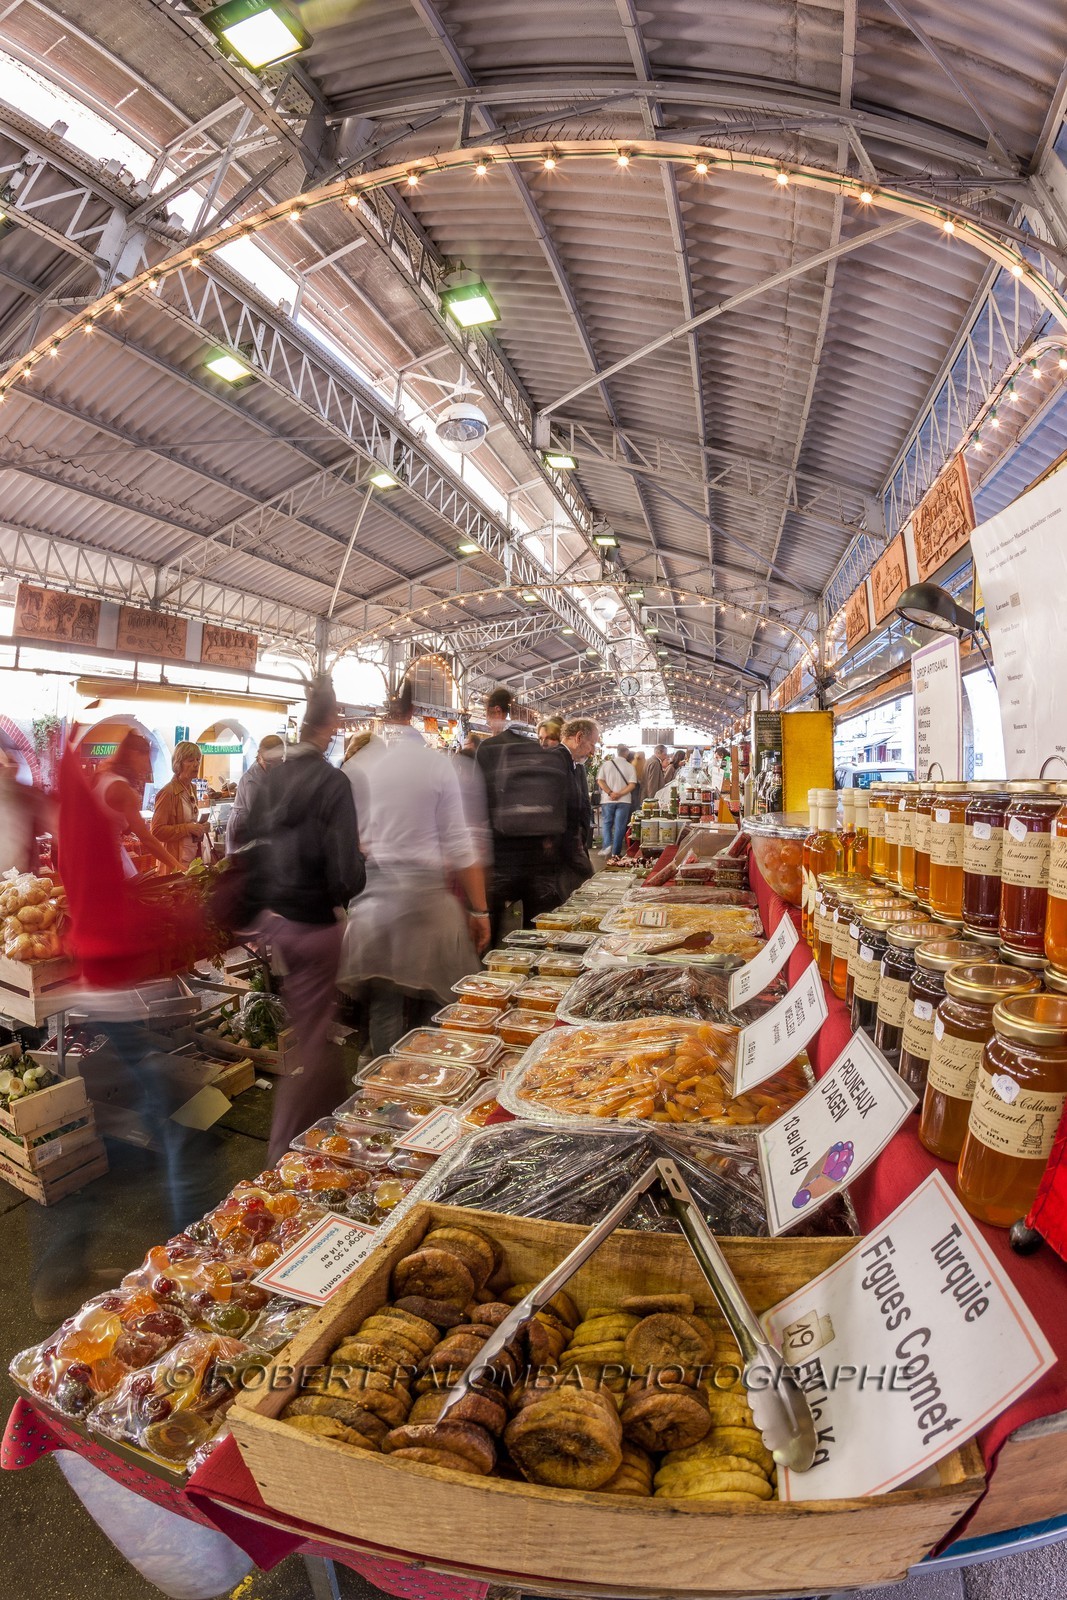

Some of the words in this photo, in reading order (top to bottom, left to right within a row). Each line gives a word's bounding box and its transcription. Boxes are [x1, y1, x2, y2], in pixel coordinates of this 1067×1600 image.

[918, 706, 931, 717] Violette
[918, 719, 931, 729] Mimosa
[918, 732, 927, 741] Rose
[969, 843, 991, 852] Forêt
[1004, 849, 1038, 862] Montagne
[1053, 858, 1067, 869] Till
[794, 997, 805, 1027] ABRICOTS
[785, 1006, 796, 1038] MOELLEUX
[935, 1055, 967, 1072] Tilleul
[838, 1058, 878, 1119] PRUNEAUX
[821, 1078, 850, 1123] D'AGEN
[1020, 1097, 1058, 1113] Collines
[982, 1100, 1027, 1124] Lavande
[784, 1115, 800, 1131] 13
[787, 1129, 801, 1146] eu
[986, 1131, 1009, 1144] DOM
[790, 1139, 807, 1157] le
[308, 1227, 340, 1254] Fabrication
[344, 1228, 358, 1240] 400
[348, 1230, 366, 1247] 250gr
[336, 1240, 344, 1248] gr
[358, 1250, 367, 1259] de
[280, 1255, 308, 1279] artisanale
[342, 1259, 360, 1274] fruits
[930, 1222, 993, 1324] Turquie
[319, 1274, 342, 1294] confits
[787, 1323, 814, 1349] 19
[860, 1235, 911, 1332] Figues
[895, 1327, 963, 1446] Comet
